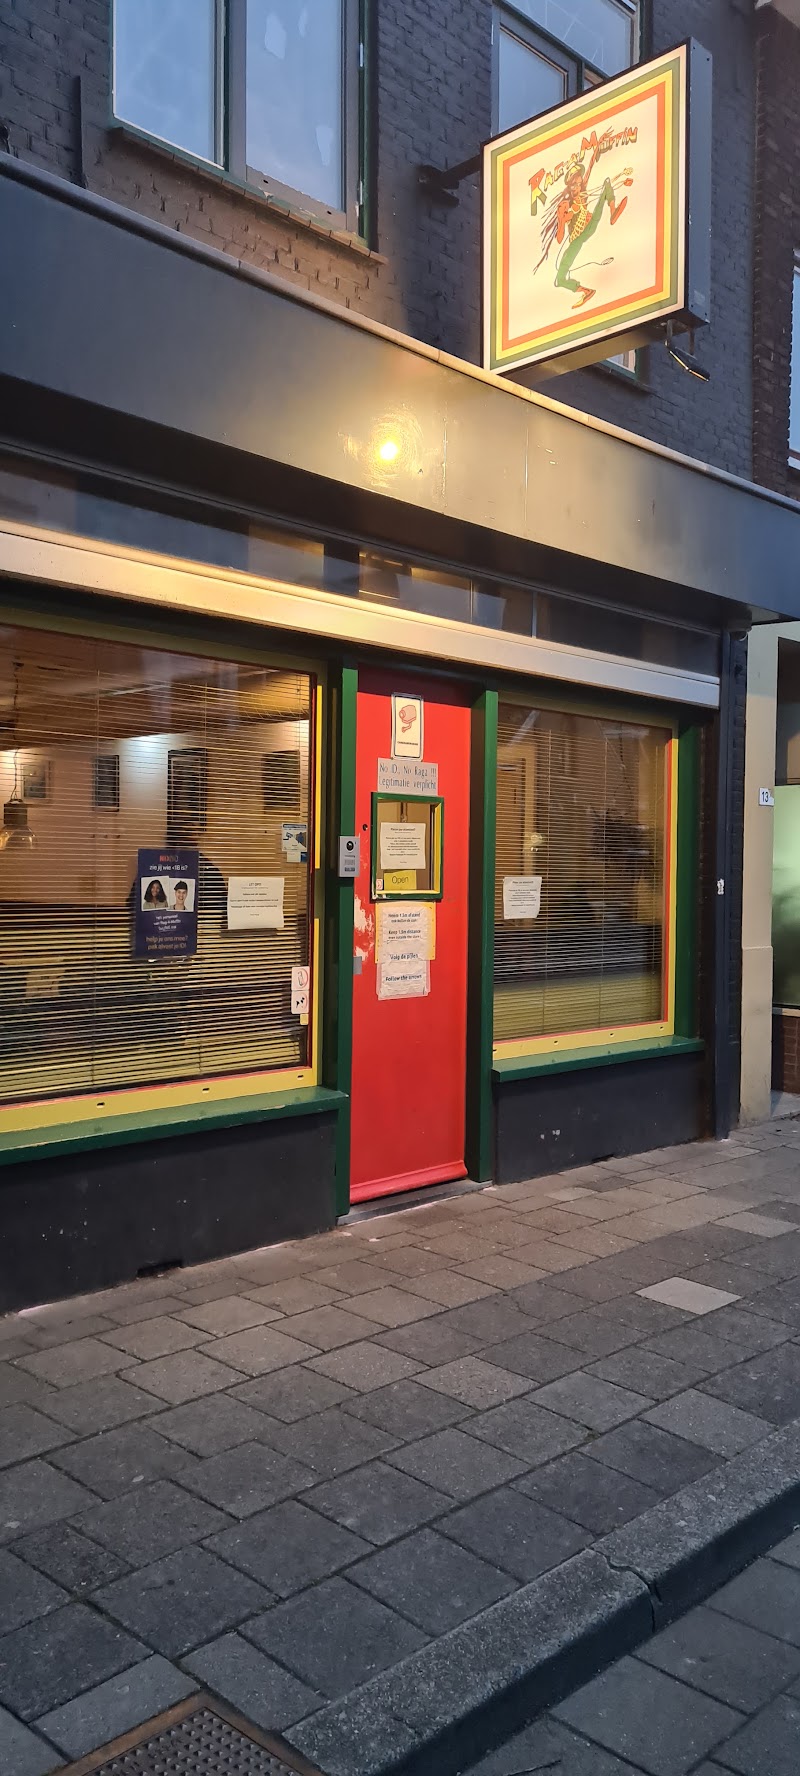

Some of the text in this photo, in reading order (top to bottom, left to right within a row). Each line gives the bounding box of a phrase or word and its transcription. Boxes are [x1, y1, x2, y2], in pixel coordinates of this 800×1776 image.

[379, 763, 389, 773] No
[403, 765, 412, 775] No
[378, 776, 437, 792] Legitimatie verplicht
[762, 791, 769, 803] 13
[391, 875, 409, 884] Open
